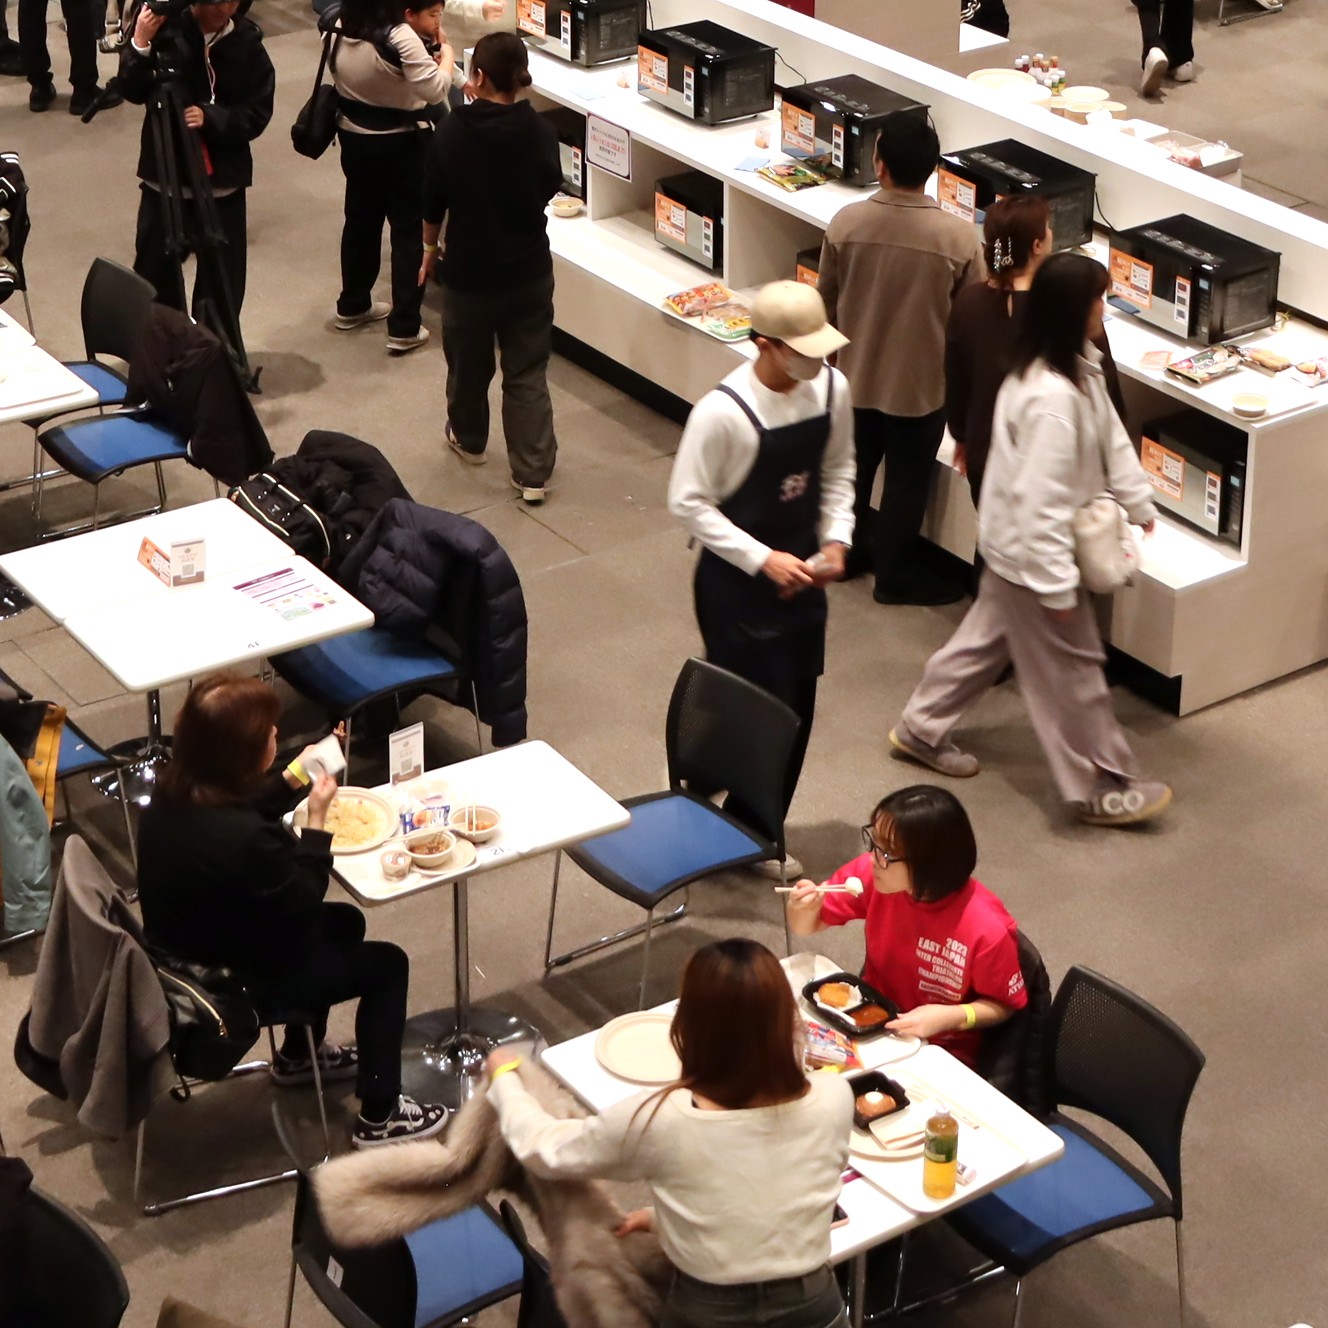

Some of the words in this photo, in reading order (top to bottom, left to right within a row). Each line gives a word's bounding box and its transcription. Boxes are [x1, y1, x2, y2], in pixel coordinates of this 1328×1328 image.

[918, 937, 941, 953] EAST
[941, 946, 966, 968] JAPAN
[946, 937, 968, 956] 2023
